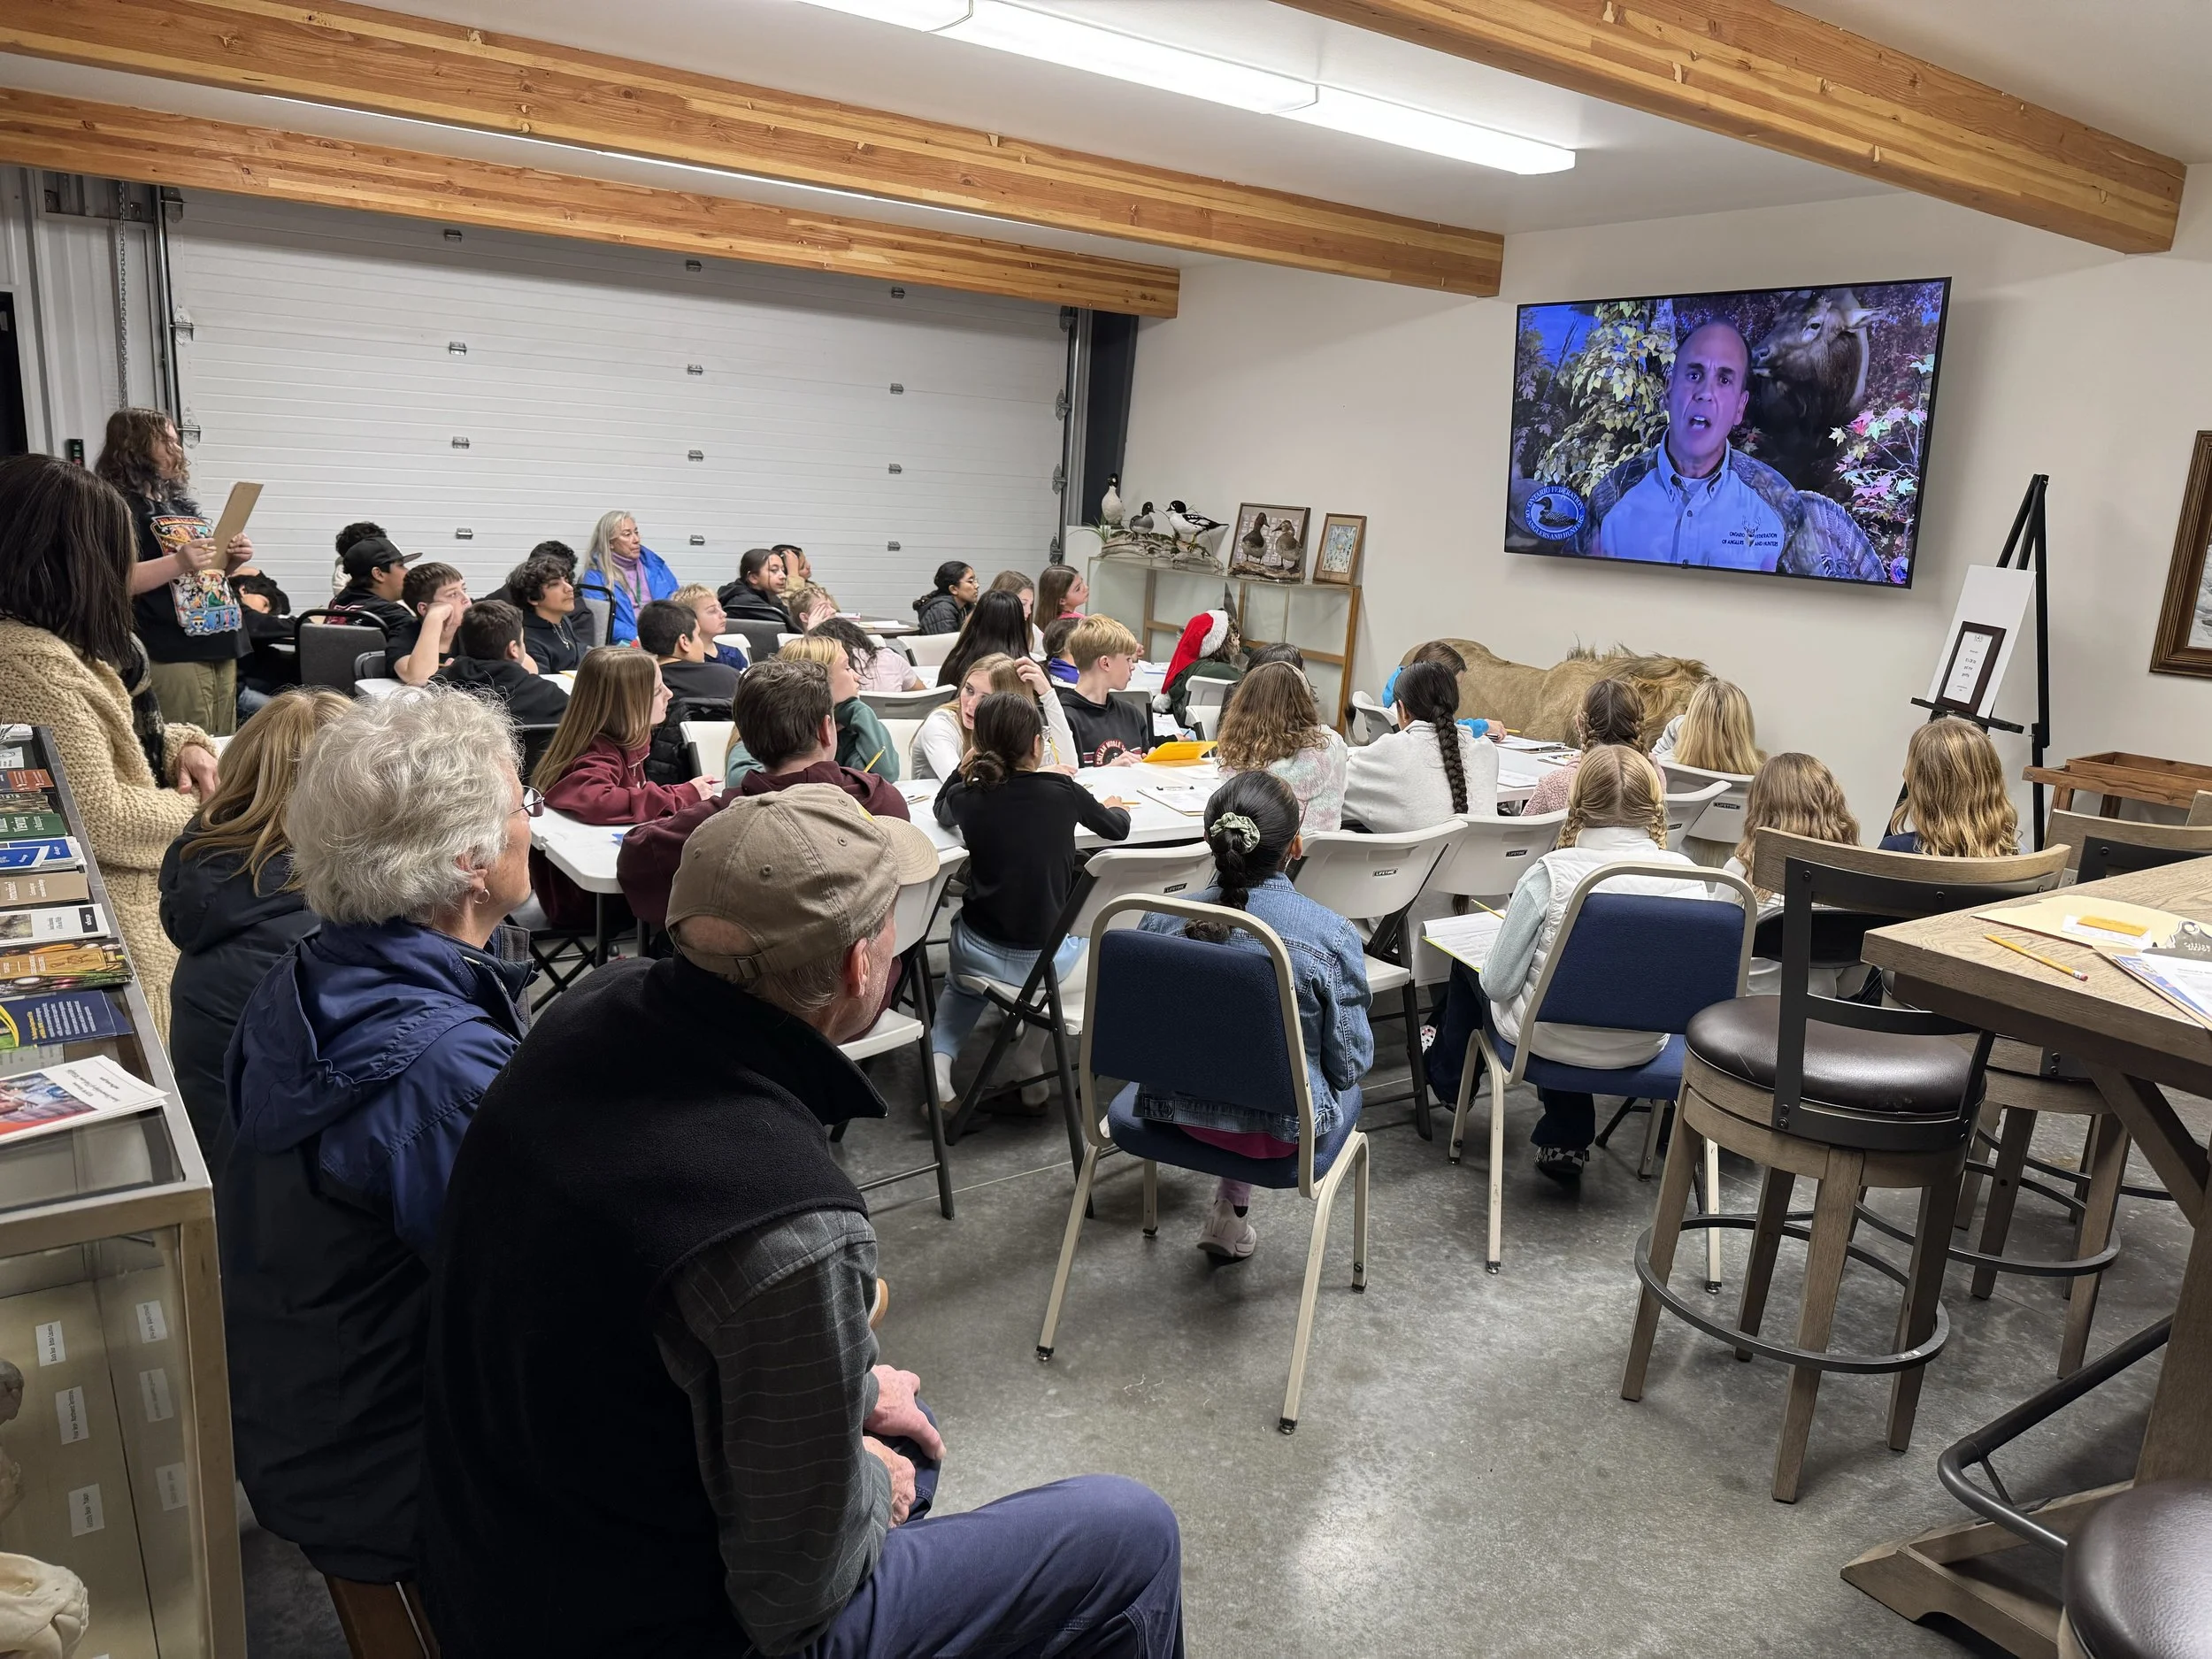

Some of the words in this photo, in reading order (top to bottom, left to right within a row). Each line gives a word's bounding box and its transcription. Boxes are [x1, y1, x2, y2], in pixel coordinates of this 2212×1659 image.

[1527, 487, 1550, 507] ONTARIO
[1551, 486, 1585, 510] FEDERATION
[1525, 511, 1531, 519] OF
[1527, 520, 1550, 538] ANGLERS
[1563, 515, 1585, 538] HUNTERS
[1097, 745, 1107, 765] CHELAN
